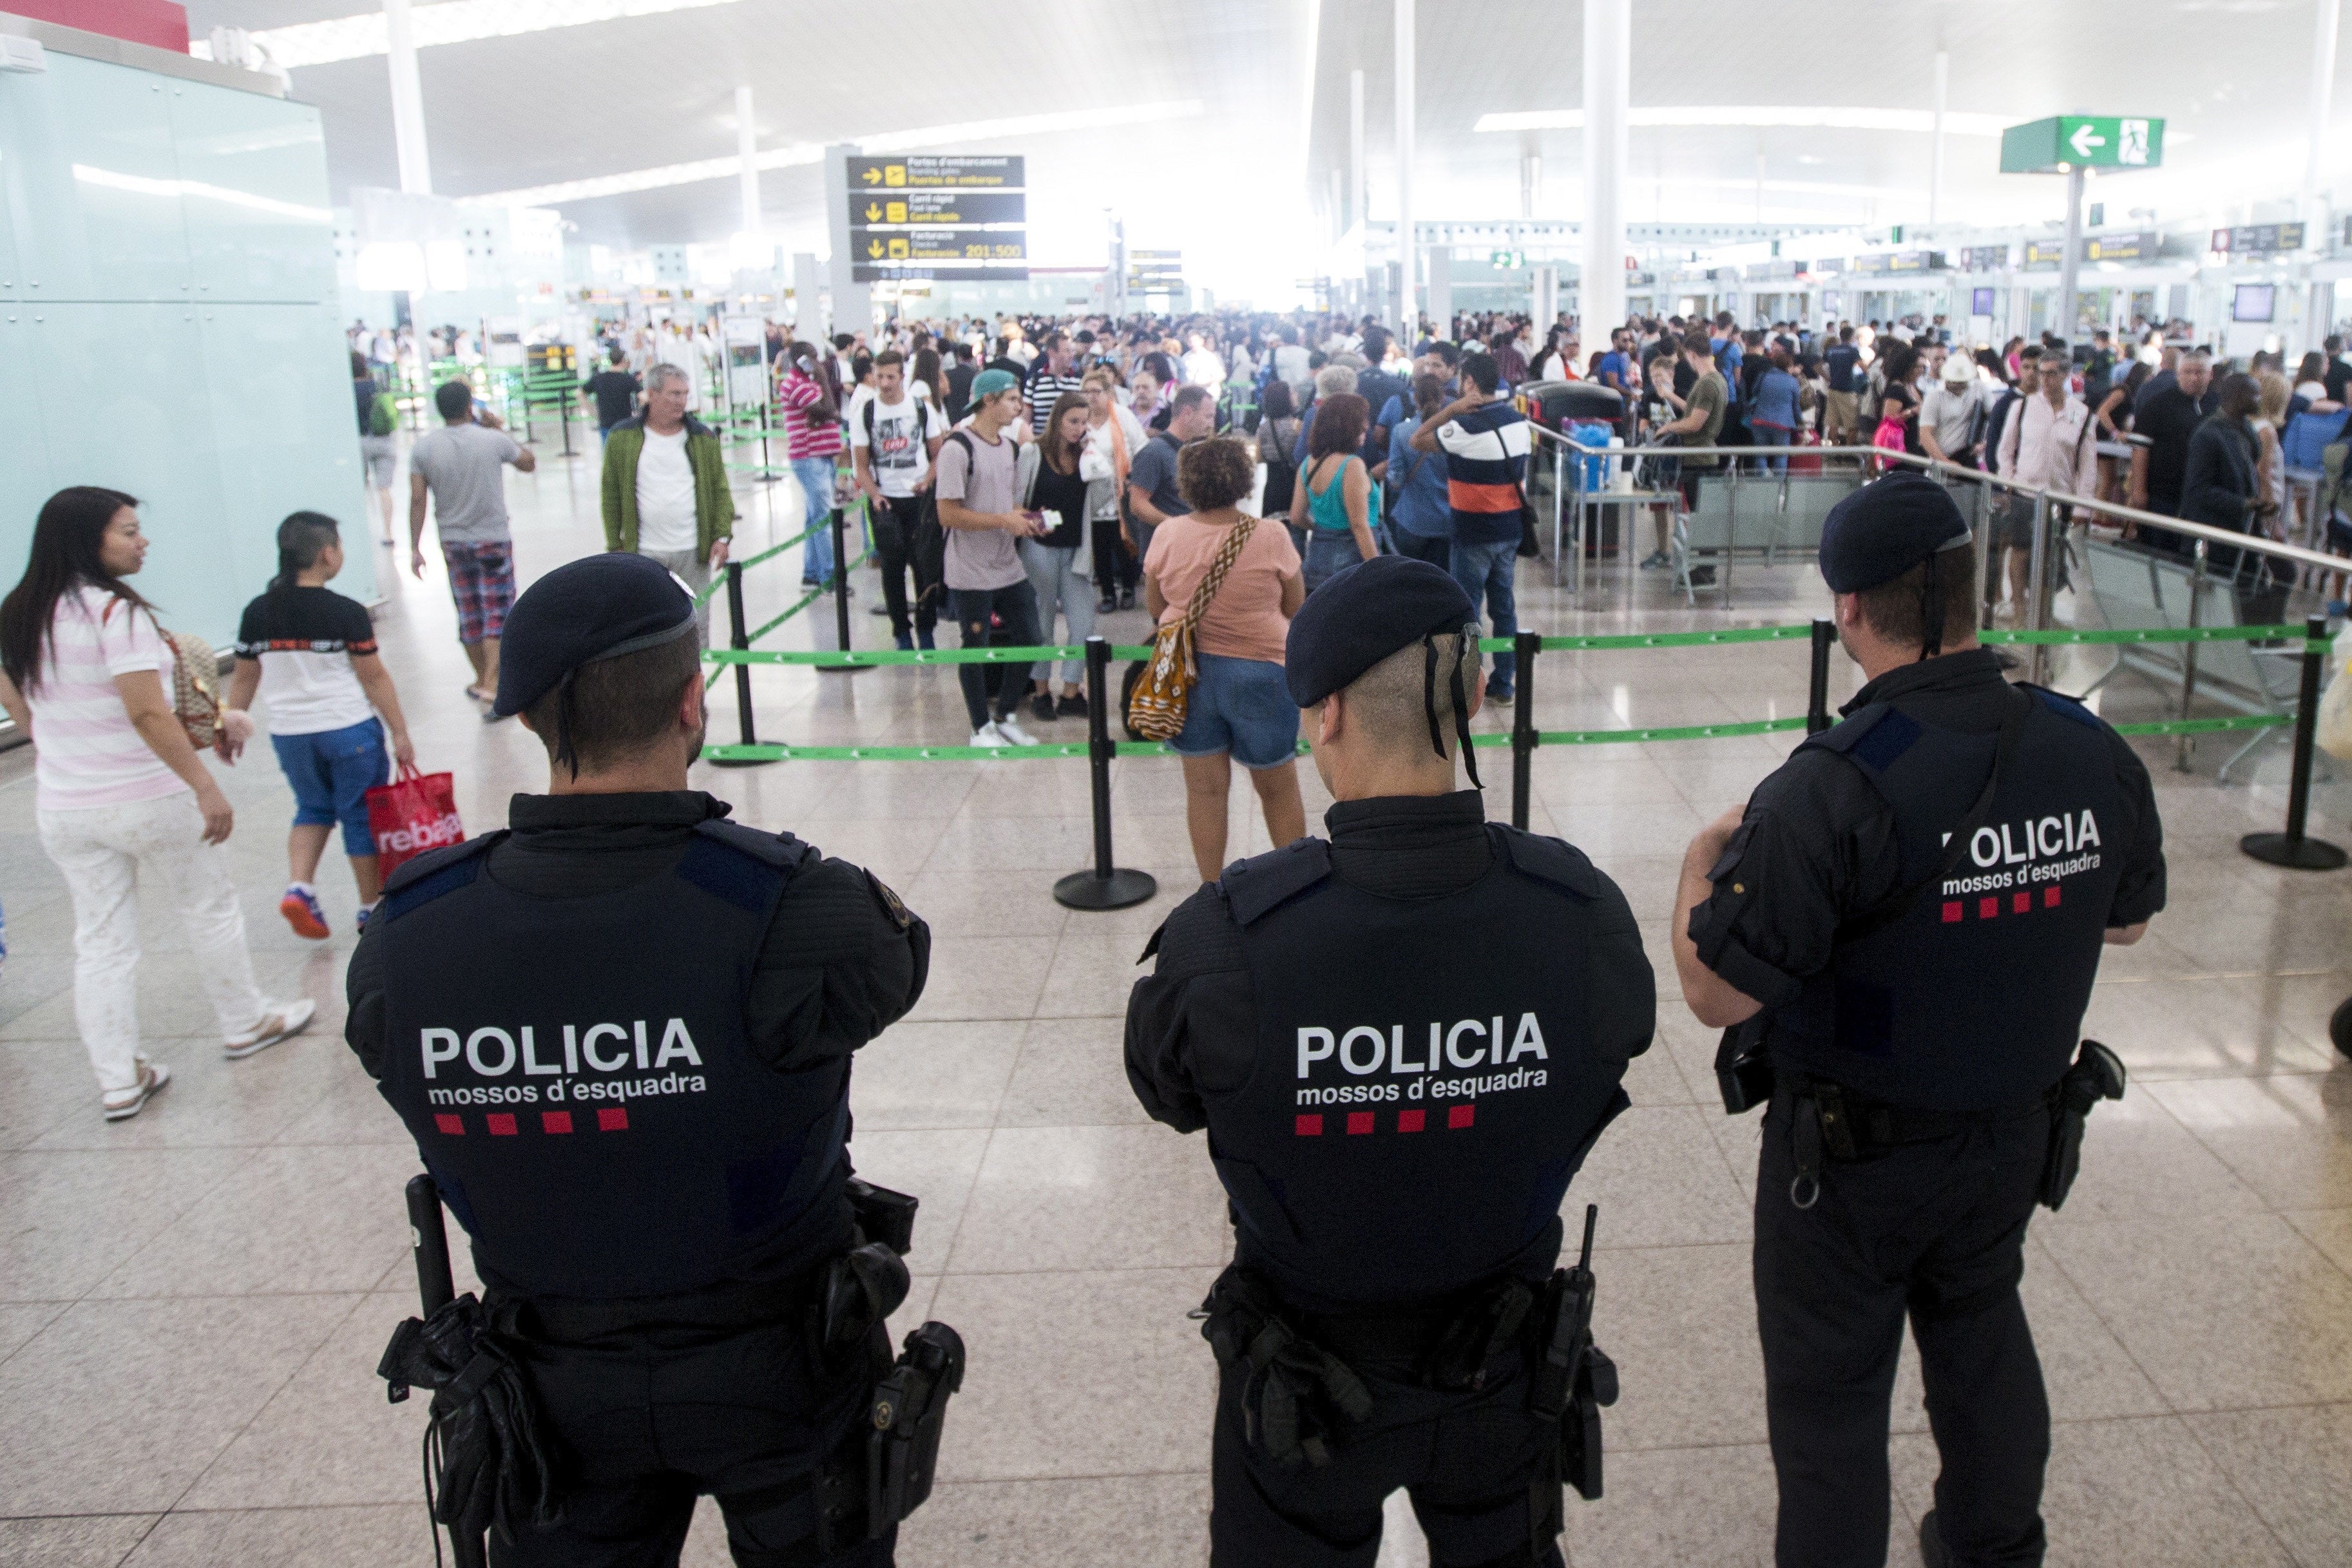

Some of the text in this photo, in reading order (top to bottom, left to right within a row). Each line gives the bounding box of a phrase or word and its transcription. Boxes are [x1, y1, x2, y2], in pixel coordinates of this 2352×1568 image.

[1942, 809, 2101, 868] OLICIA
[1942, 872, 2013, 895] mossos
[420, 1018, 703, 1079] POLICIA
[1297, 1012, 1549, 1079] POLICIA
[428, 1085, 539, 1105] mossos
[1296, 1084, 1400, 1105] mossos
